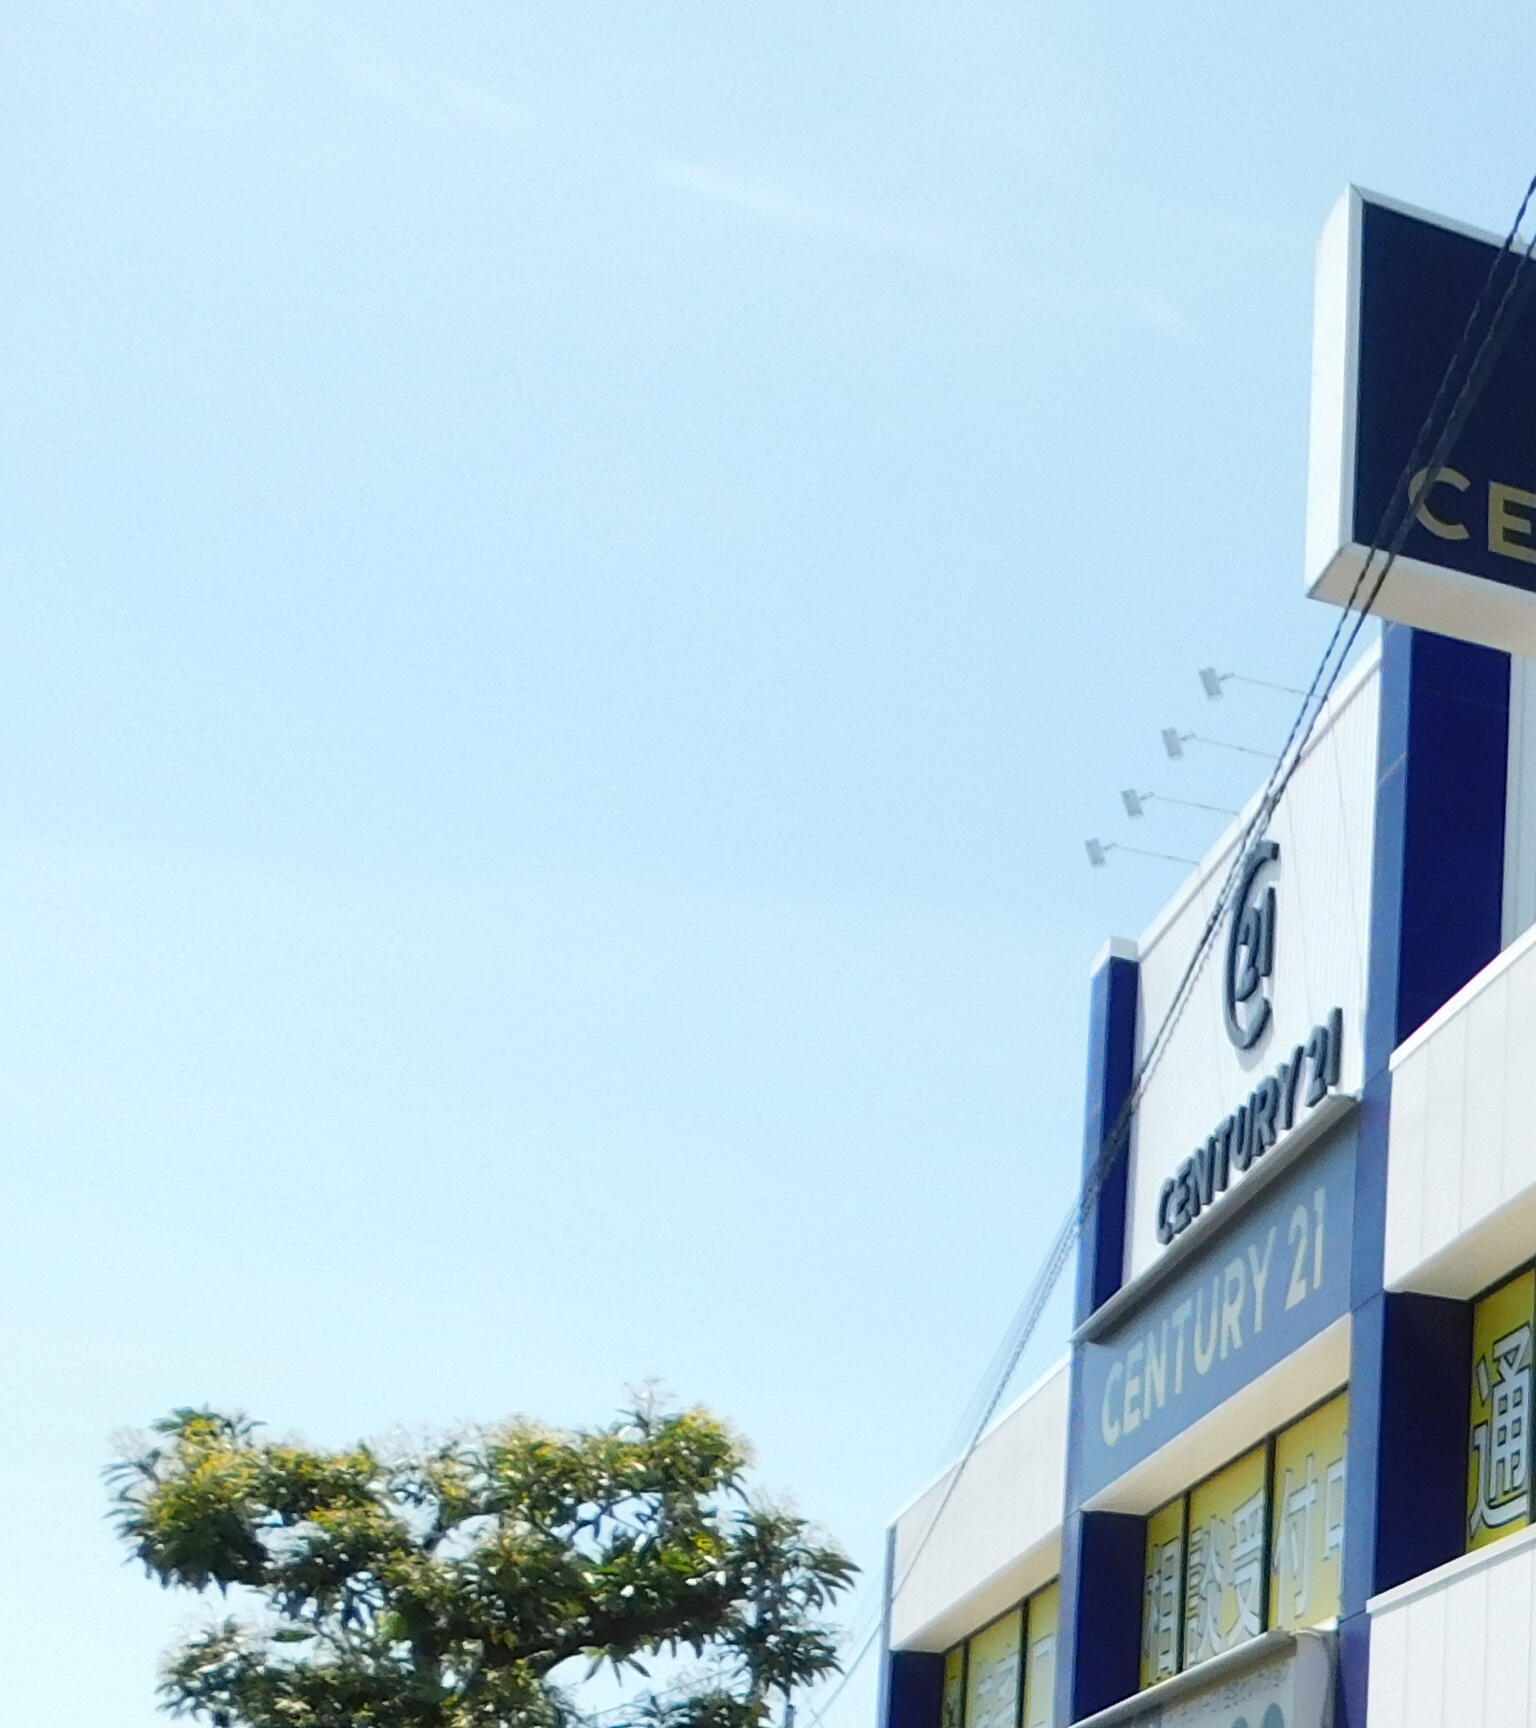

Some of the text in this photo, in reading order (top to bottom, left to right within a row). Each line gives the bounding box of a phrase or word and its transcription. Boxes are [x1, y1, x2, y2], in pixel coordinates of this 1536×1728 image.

[1157, 1007, 1343, 1245] CENTURY 21
[1101, 1187, 1327, 1447] CENTURY 21
